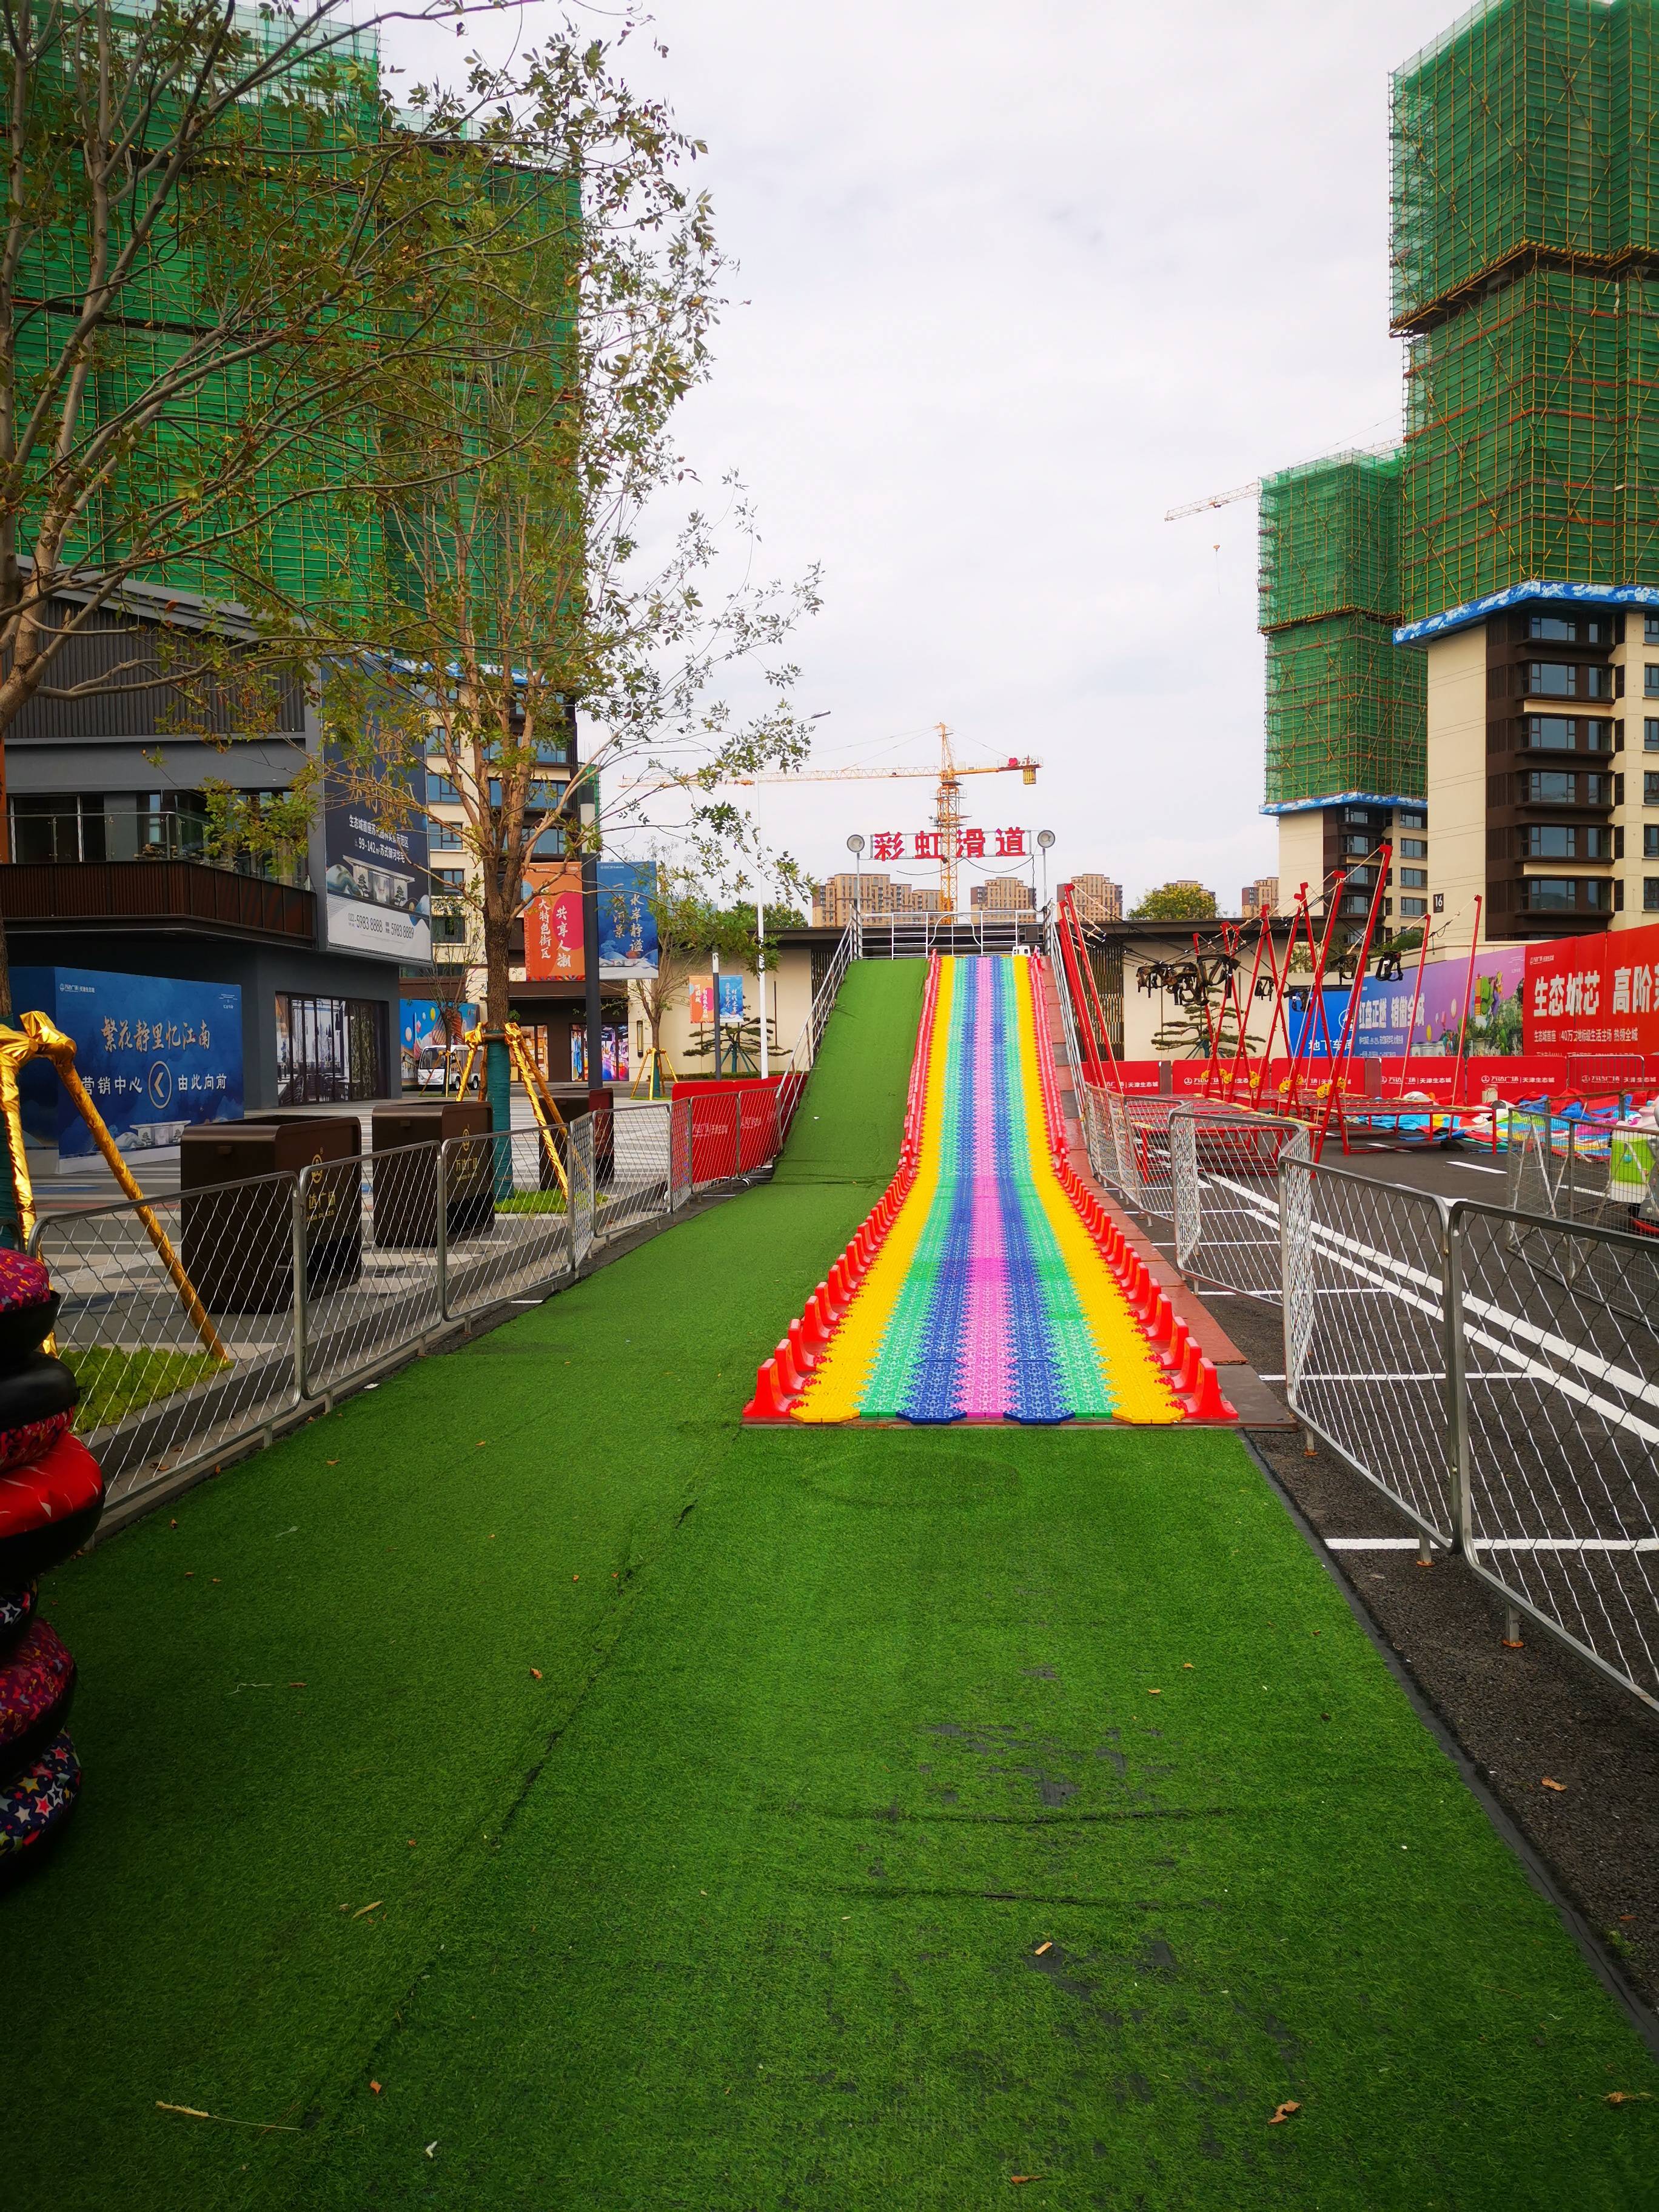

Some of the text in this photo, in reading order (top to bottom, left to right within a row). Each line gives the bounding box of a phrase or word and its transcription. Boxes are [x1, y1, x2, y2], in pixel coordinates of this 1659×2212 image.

[874, 826, 1026, 861] 彩虹滑道
[1435, 896, 1443, 907] 16
[555, 905, 572, 968] 共享人潮
[630, 893, 645, 952] 水岸静谧
[1533, 970, 1600, 1017] 生态城芯
[101, 1016, 210, 1053] 繁花静里忆江南
[82, 1076, 142, 1095] 营销中心
[178, 1073, 227, 1091] 由此向前
[309, 1191, 336, 1209] 达广场
